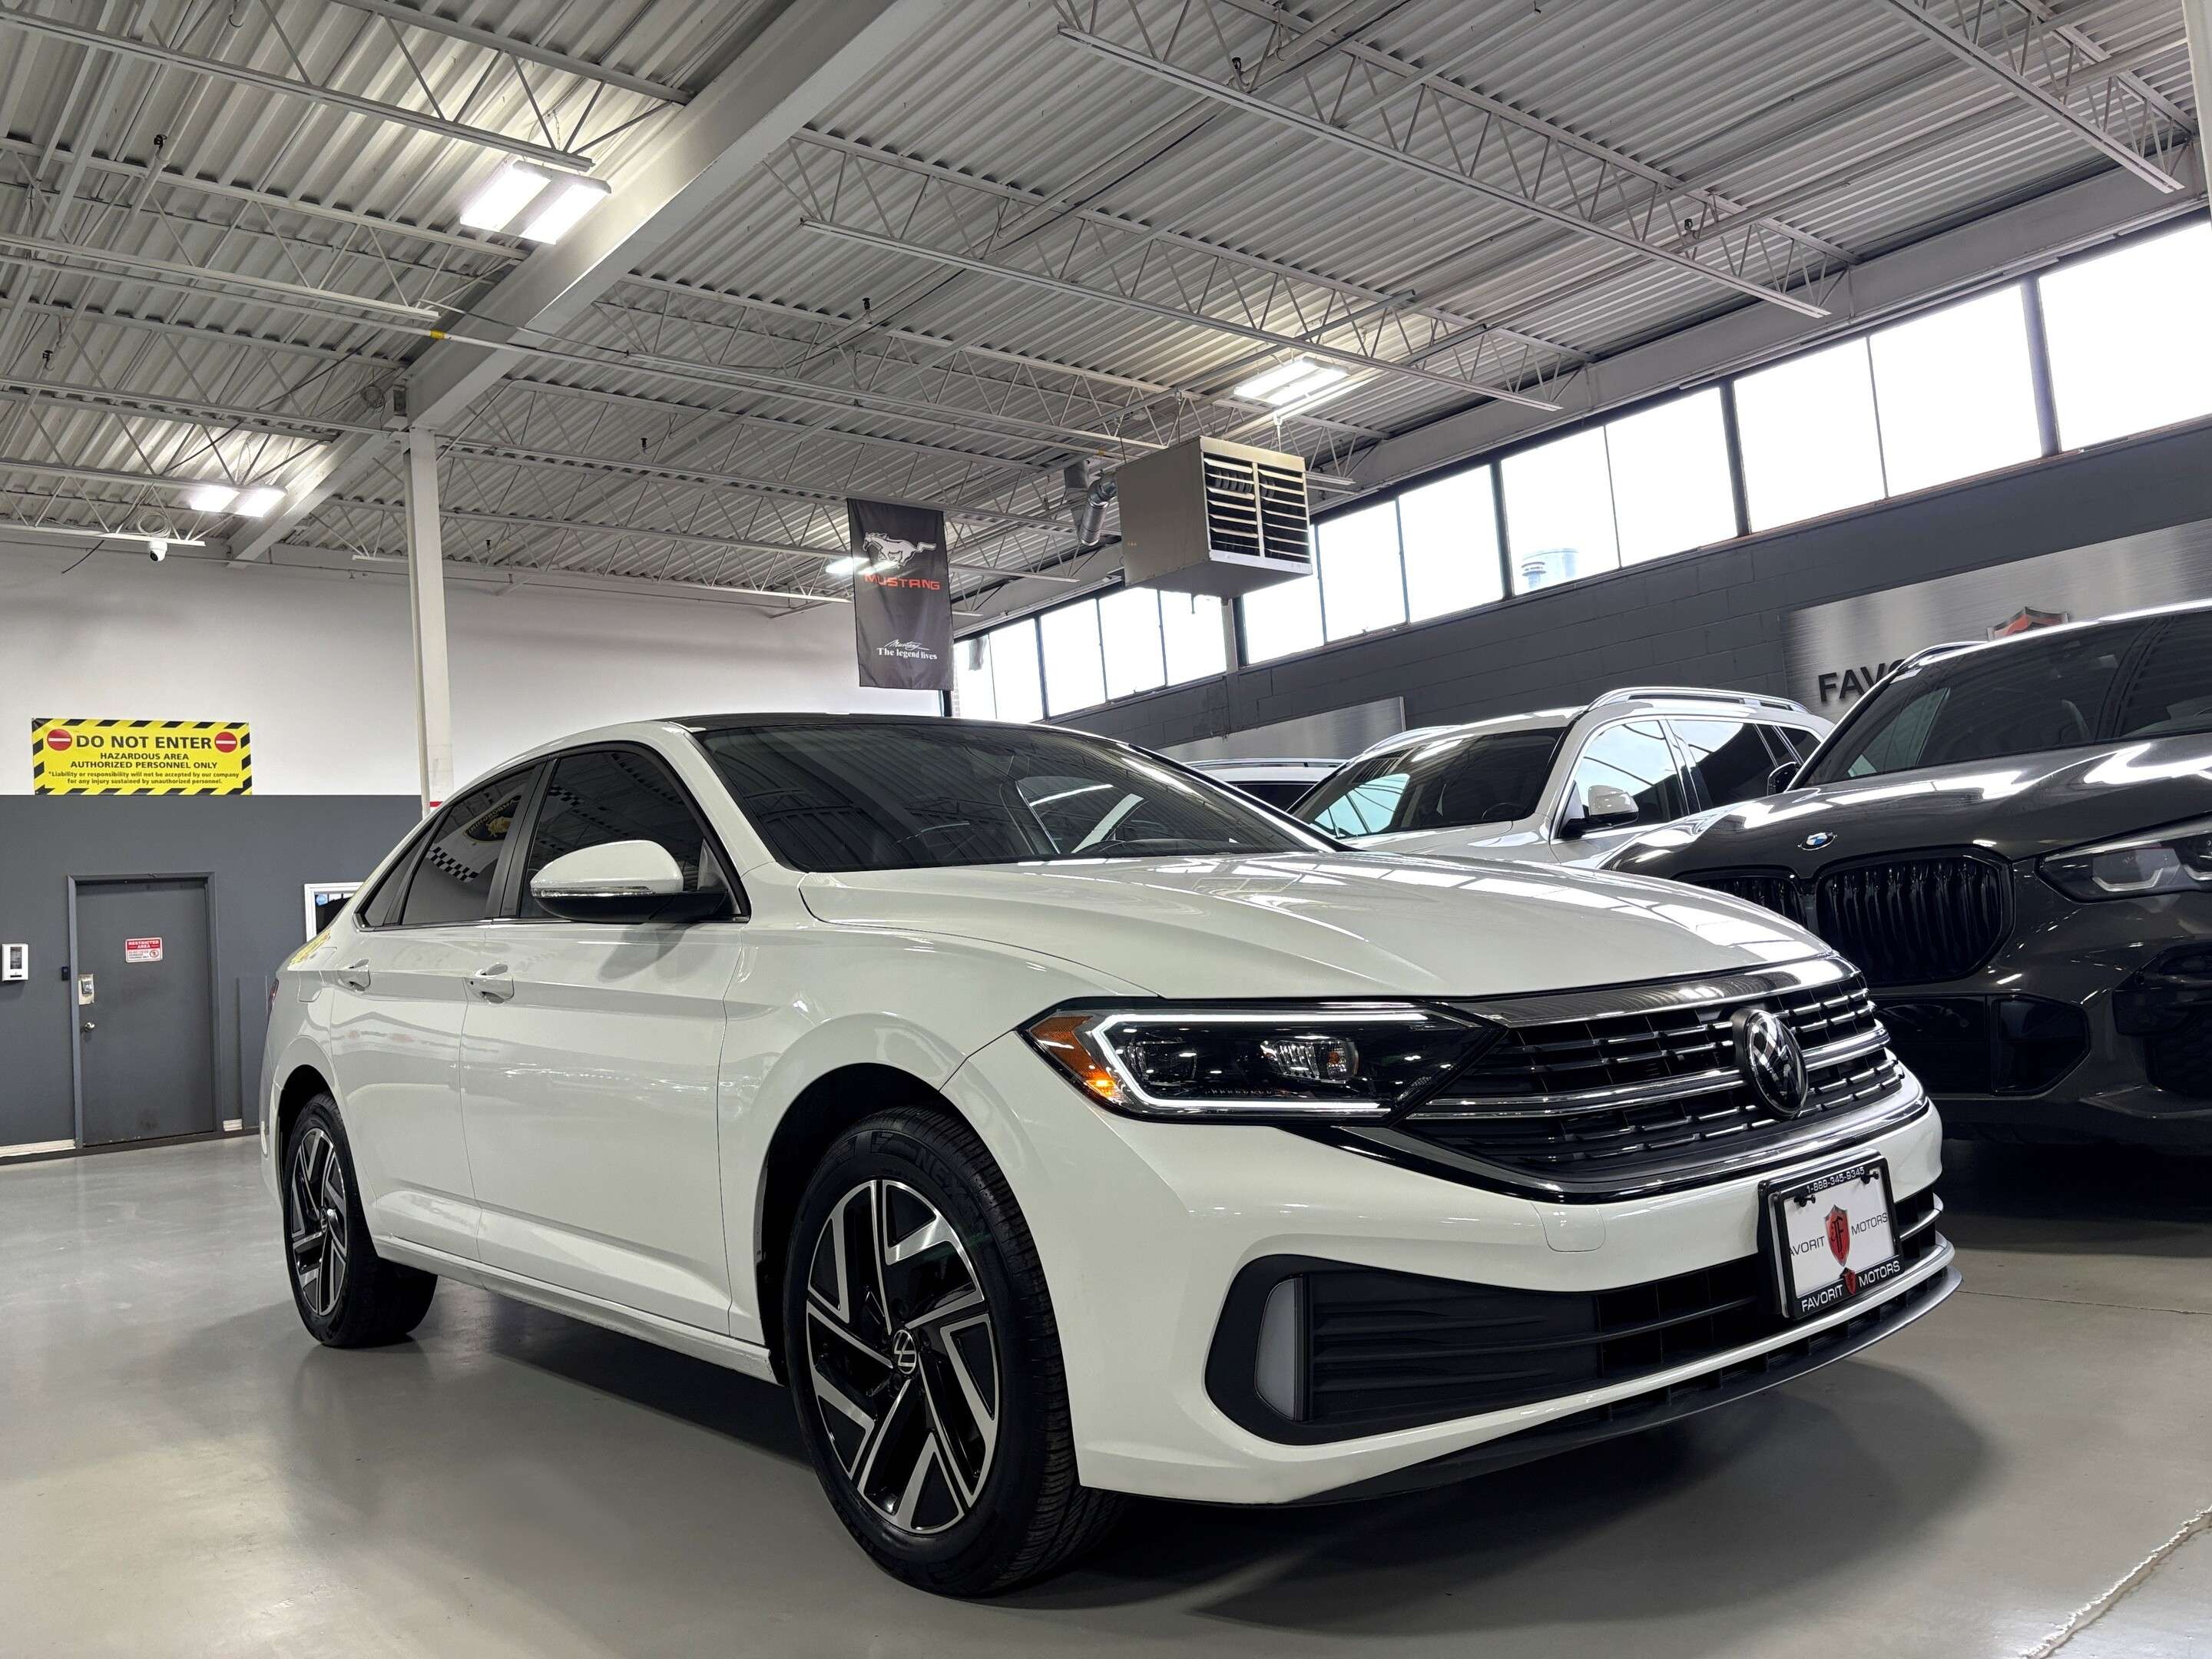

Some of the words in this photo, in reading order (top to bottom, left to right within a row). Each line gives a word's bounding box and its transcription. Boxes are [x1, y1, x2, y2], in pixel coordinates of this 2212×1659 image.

[865, 574, 940, 590] MUSTANG
[876, 647, 895, 656] The
[896, 648, 919, 658] legend
[921, 651, 937, 660] lives
[76, 735, 104, 747] DO
[111, 736, 149, 748] NOT
[155, 737, 212, 749] ENTER
[1806, 1167, 1865, 1193] 1-888-345-9345
[1789, 1236, 1825, 1257] AVORIT
[1851, 1212, 1888, 1235] MOTORS
[1801, 1284, 1843, 1312] FAVORIT
[1858, 1260, 1901, 1287] MOTORS
